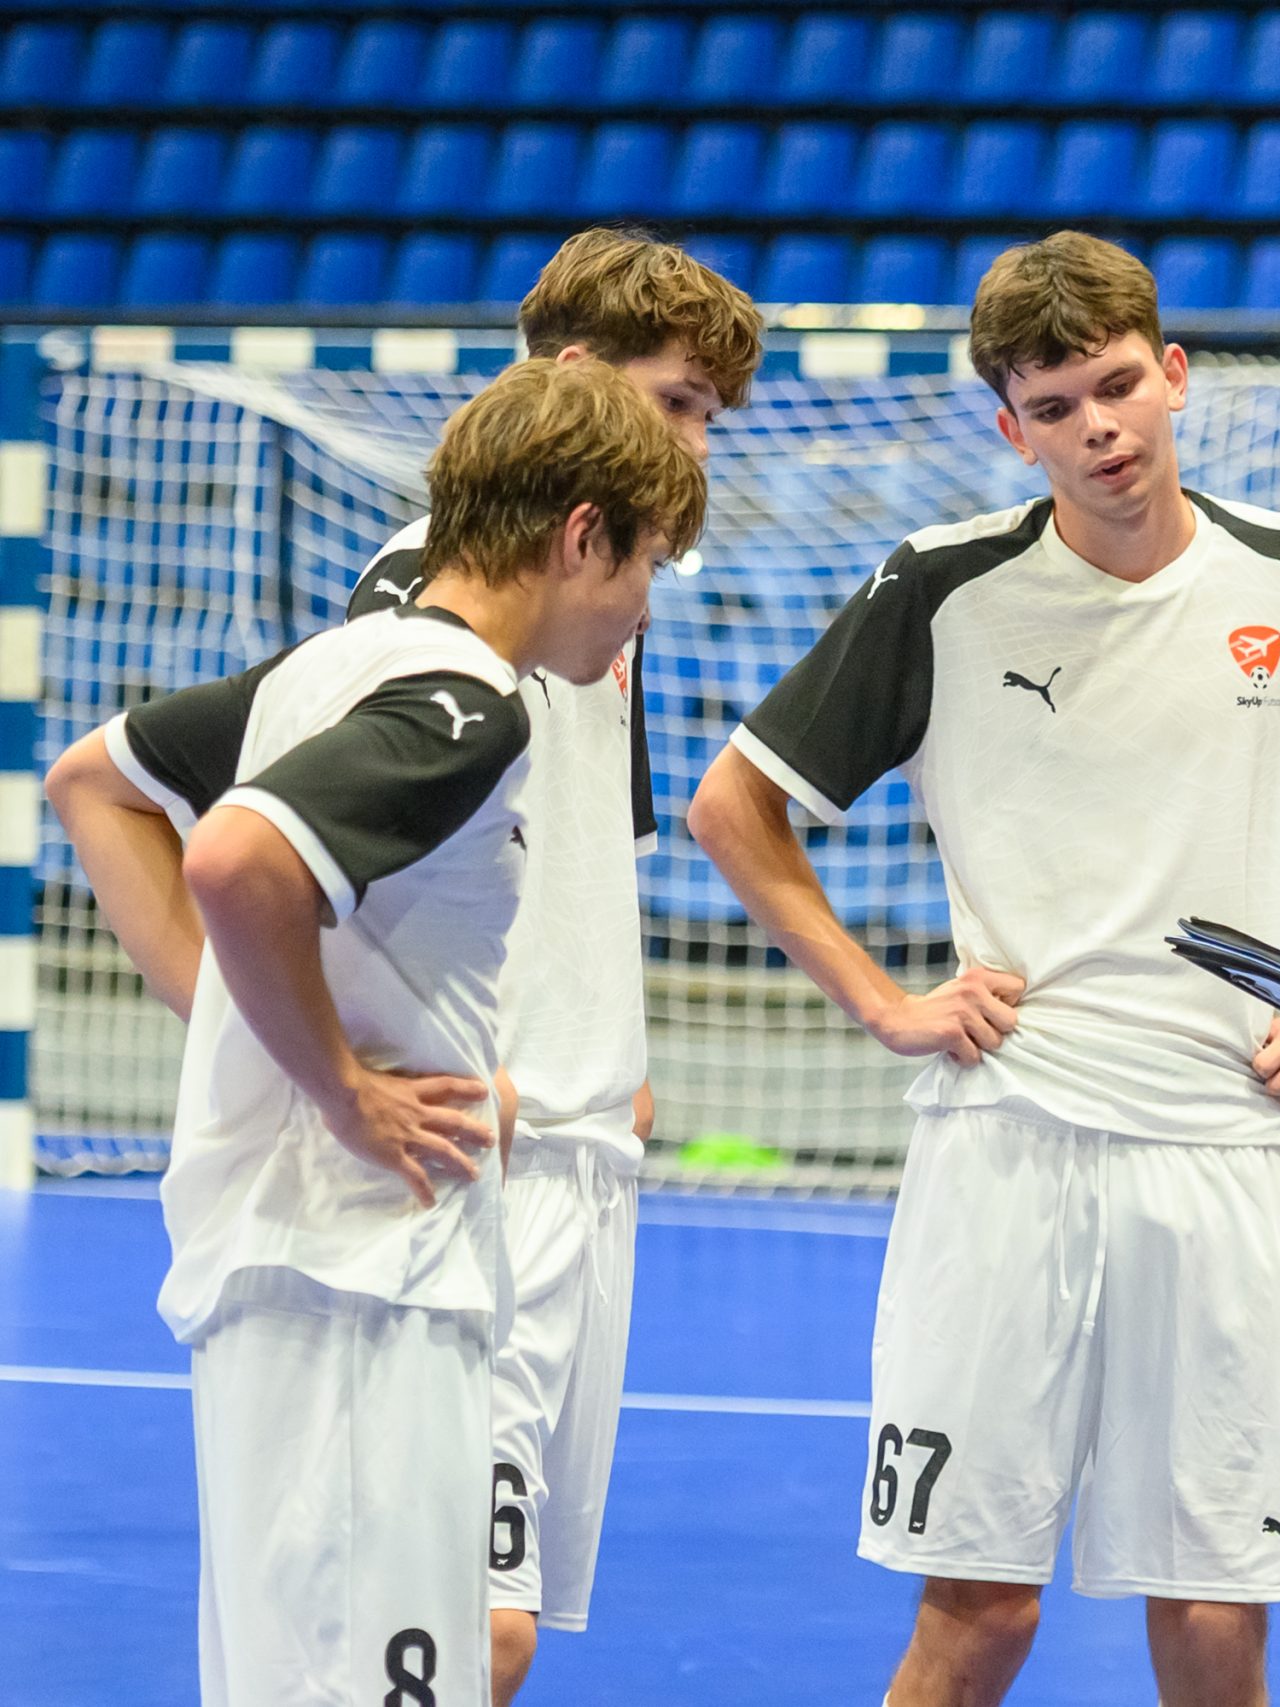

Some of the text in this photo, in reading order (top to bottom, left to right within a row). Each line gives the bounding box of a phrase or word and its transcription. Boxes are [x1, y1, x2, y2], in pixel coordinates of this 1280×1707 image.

[489, 1462, 528, 1572] 6
[870, 1423, 953, 1536] 67
[384, 1628, 437, 1707] 8
